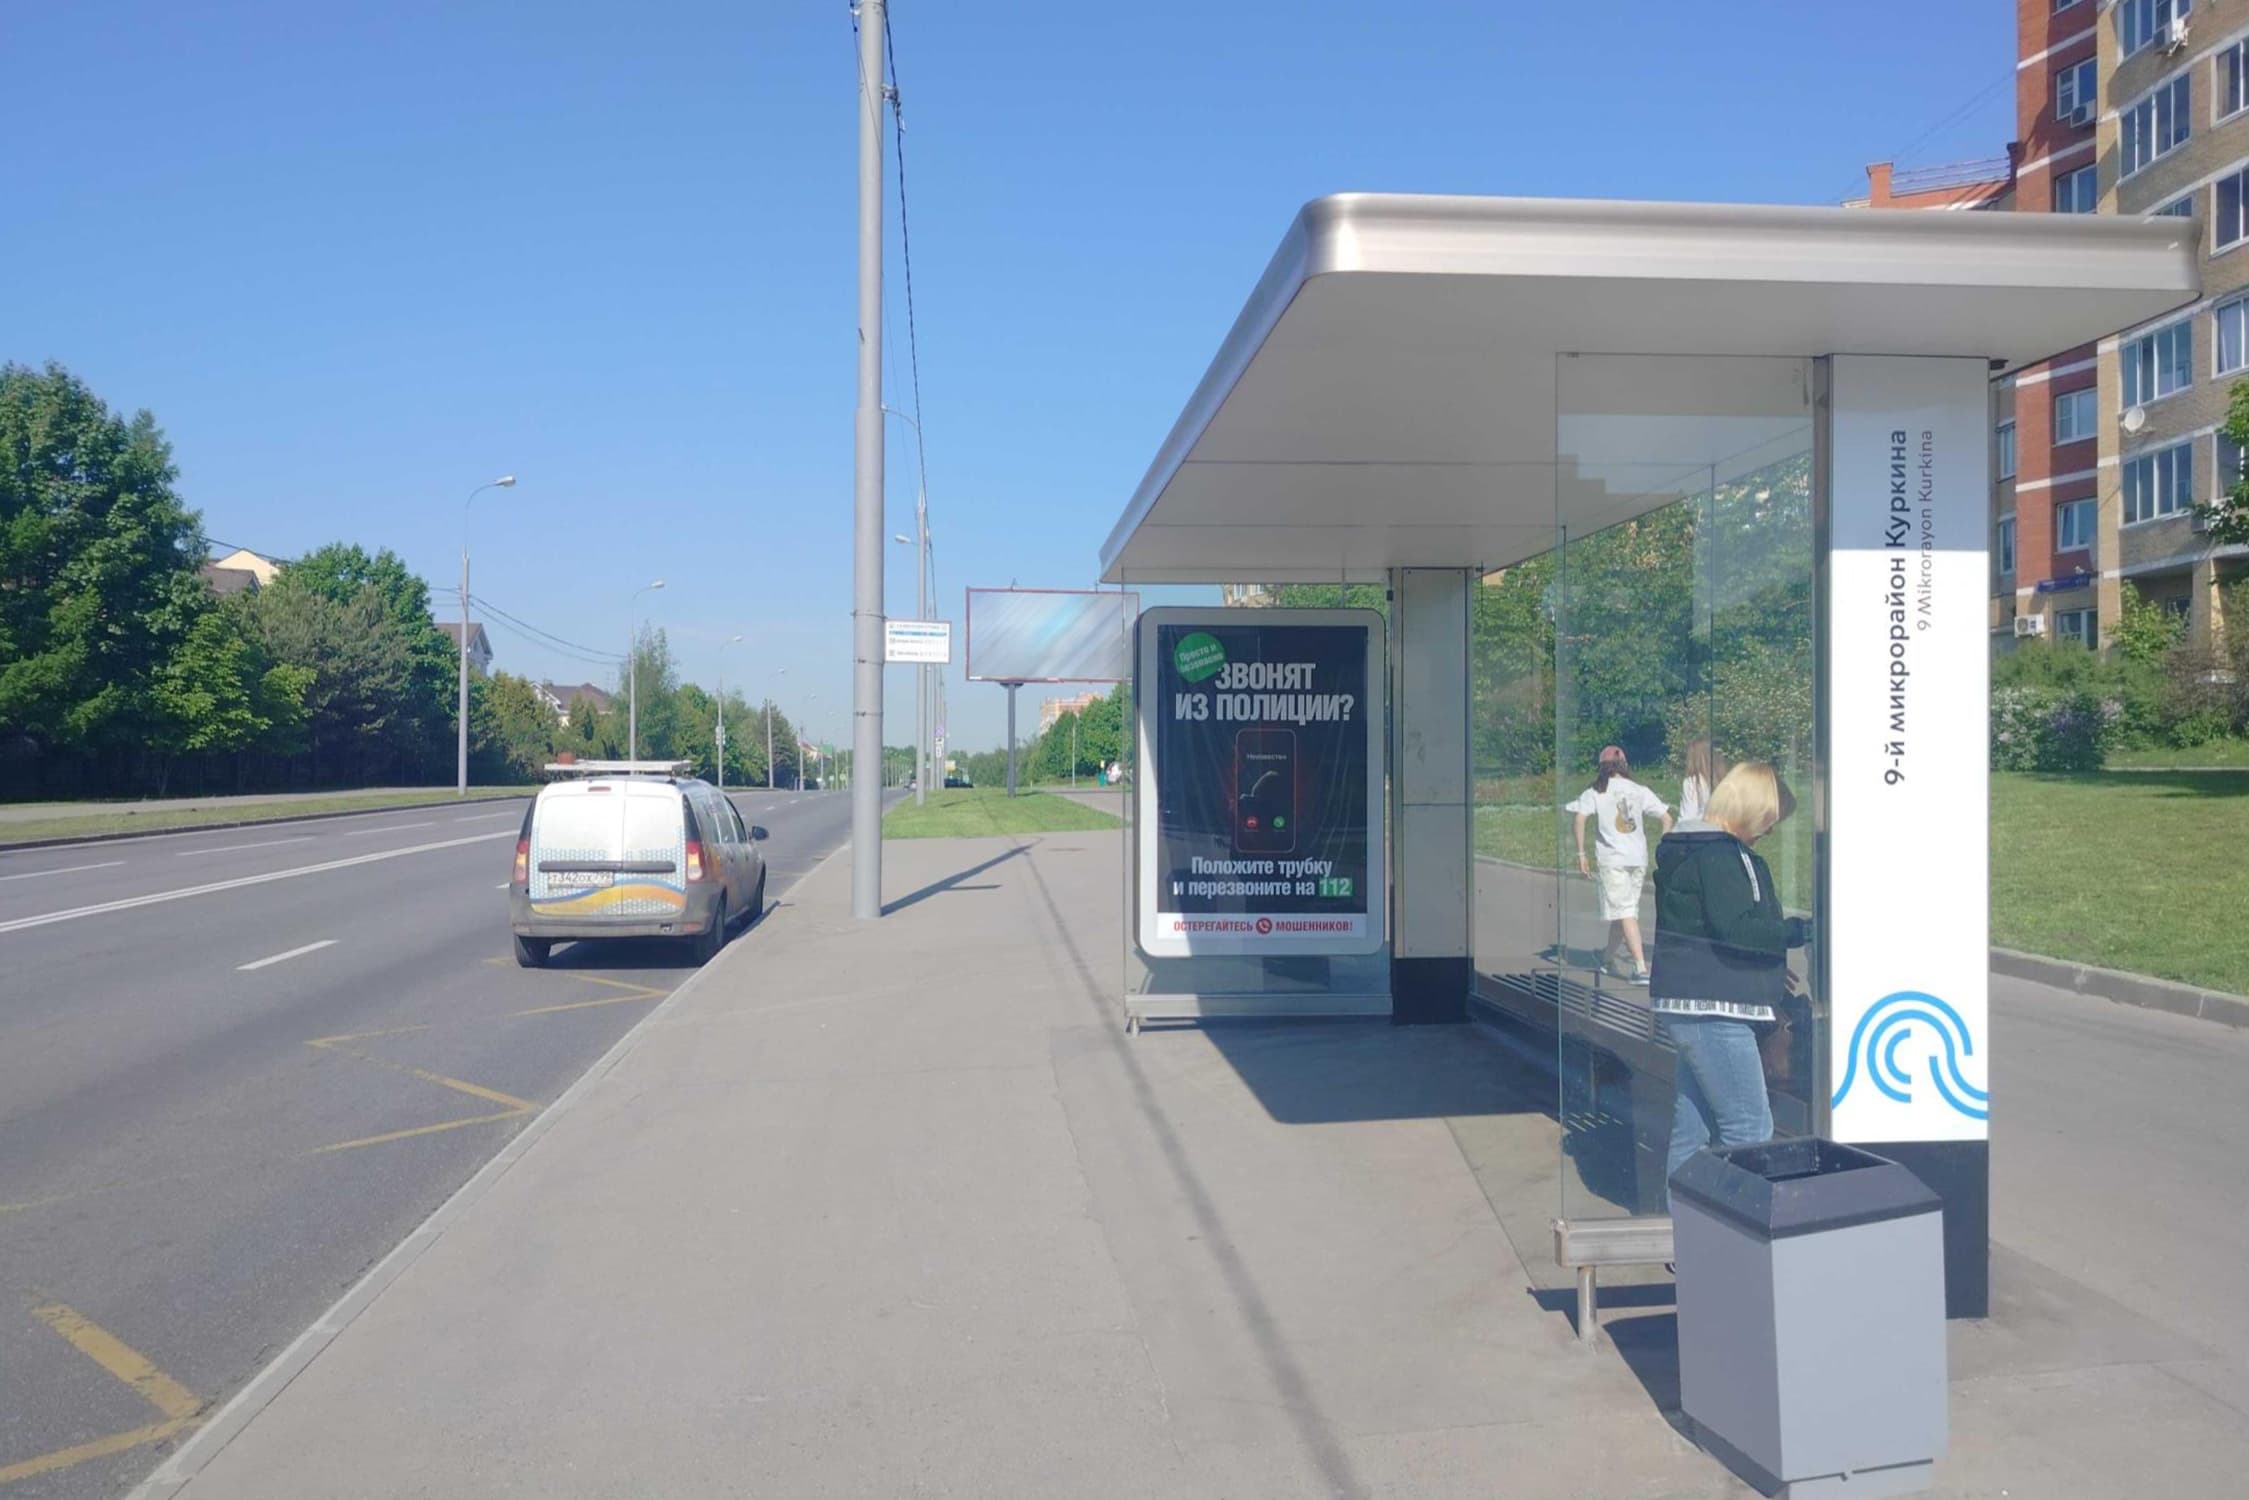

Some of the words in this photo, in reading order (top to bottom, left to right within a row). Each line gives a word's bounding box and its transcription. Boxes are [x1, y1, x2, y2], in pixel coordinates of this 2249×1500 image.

[1918, 430, 1933, 502] Kurkina
[1885, 430, 1911, 548] Куркина
[1917, 507, 1935, 615] Mikrorayon
[1917, 619, 1932, 631] 9
[1885, 558, 1910, 732] микрорайон
[1215, 662, 1316, 689] ЗВОНЯТ
[1175, 693, 1209, 721] ИЗ
[1216, 693, 1354, 725] ПОЛИЦИИ?
[1884, 741, 1906, 786] 9-й
[1191, 856, 1274, 875] Положите
[1278, 856, 1333, 877] трубку
[1173, 881, 1184, 895] и
[1188, 880, 1292, 899] перезвоните
[1295, 880, 1315, 895] на
[1320, 878, 1351, 896] 112
[1173, 919, 1253, 933] ОСТЕРЕГАЙТЕСЬ
[1275, 919, 1353, 932] МОШЕННИКОВ!
